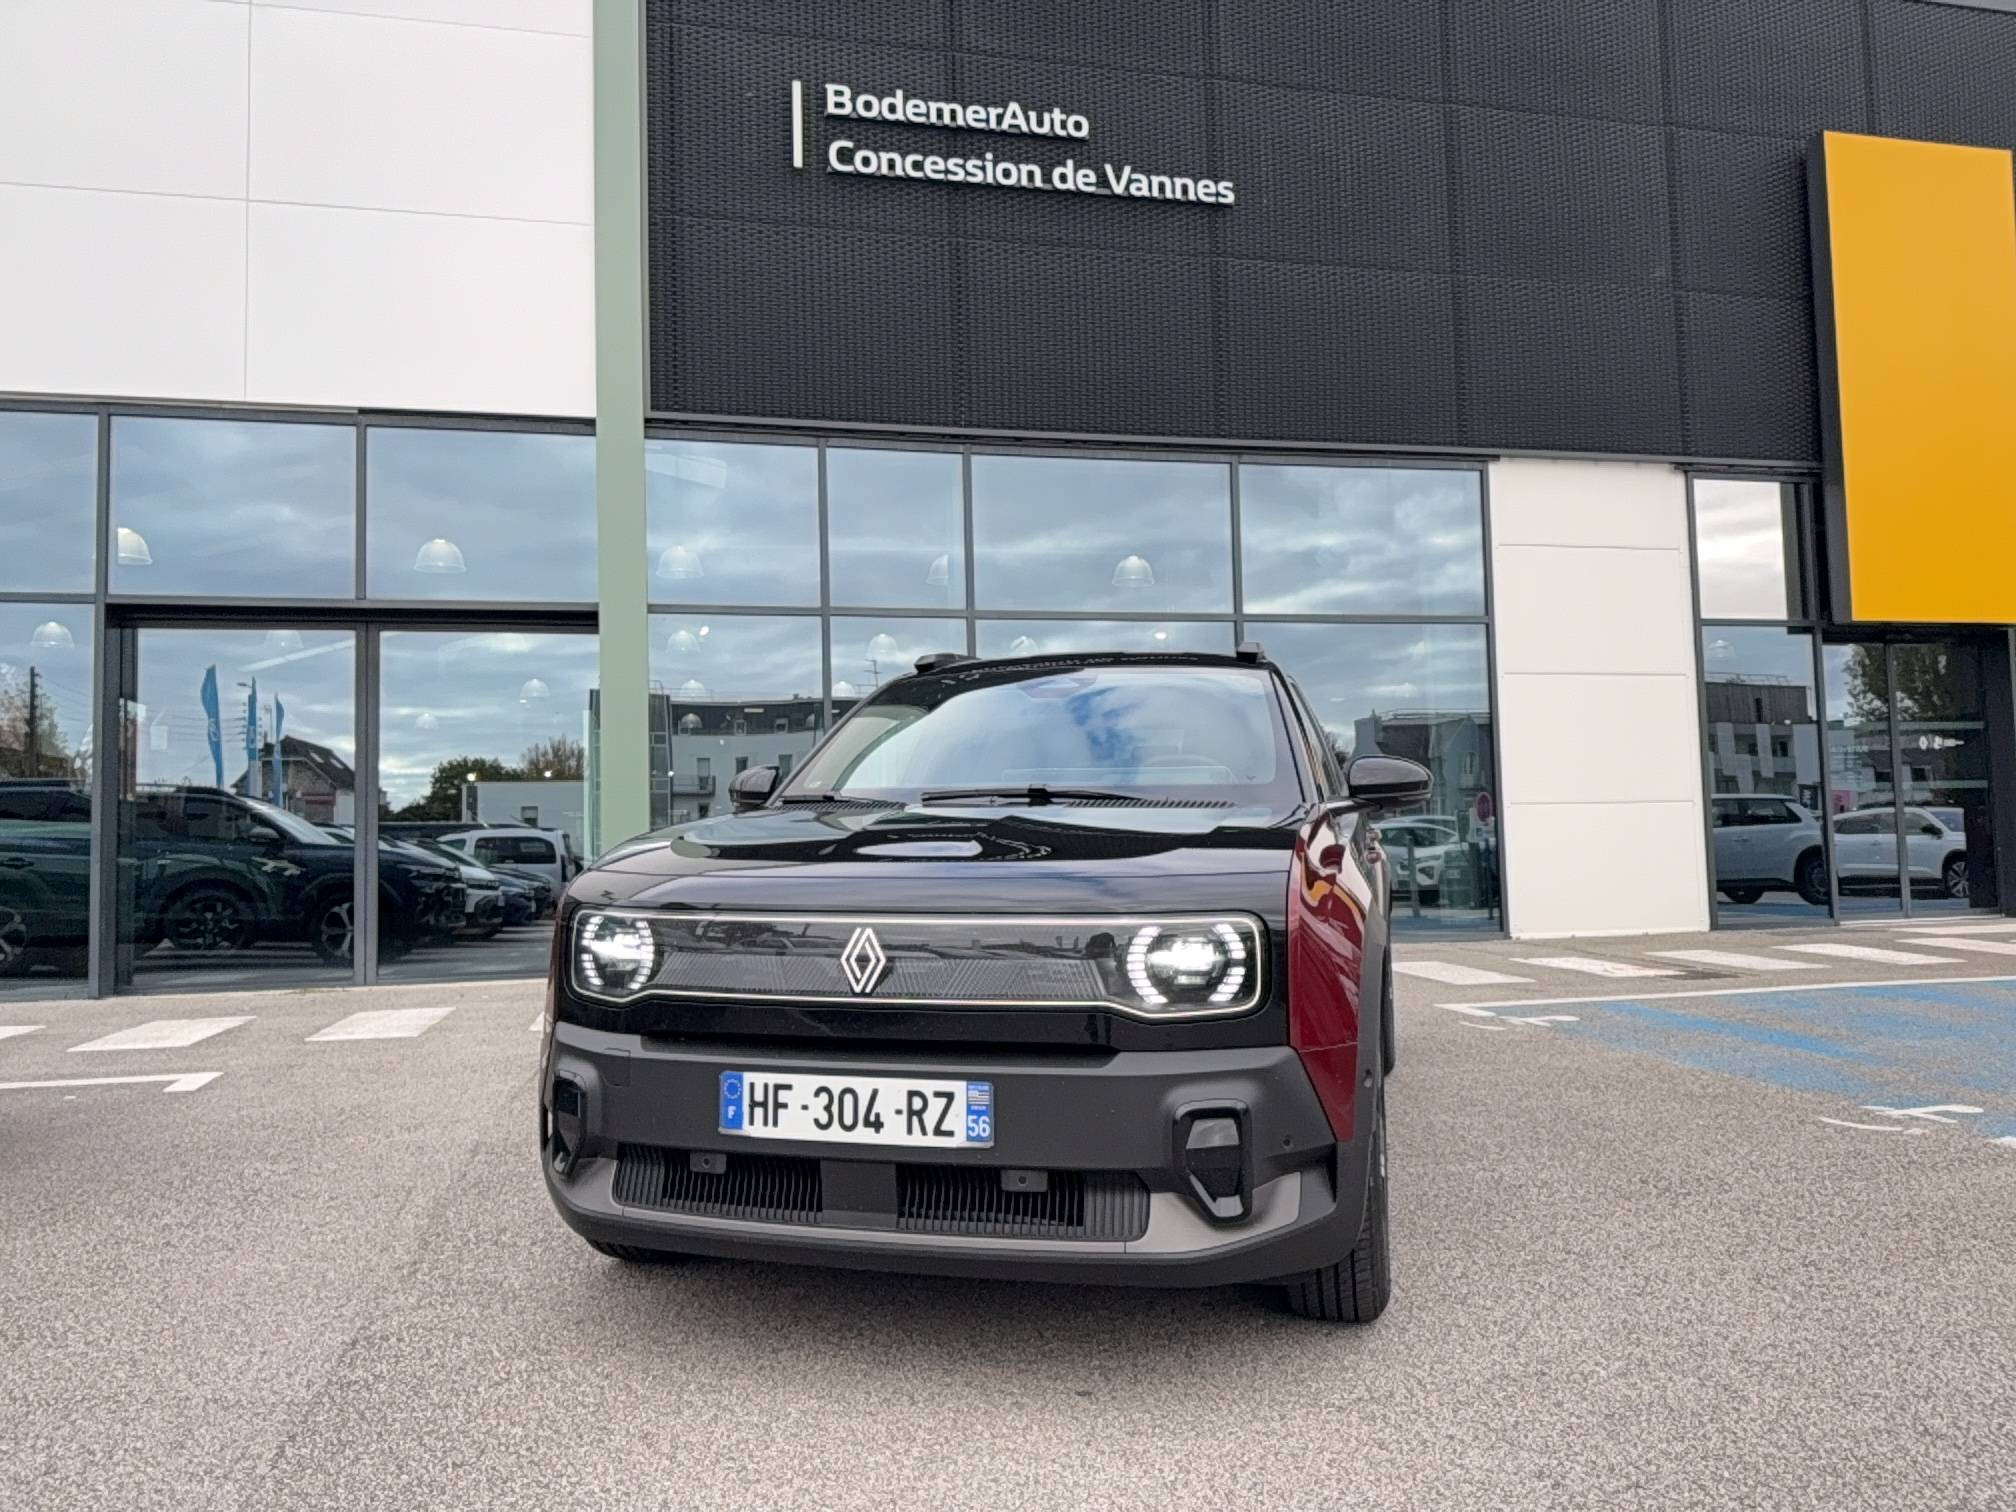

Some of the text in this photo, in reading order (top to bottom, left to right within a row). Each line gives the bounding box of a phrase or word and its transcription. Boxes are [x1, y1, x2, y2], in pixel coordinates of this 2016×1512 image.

[825, 83, 1090, 139] BodemerAuto
[827, 140, 1236, 204] Concession de Vannes
[727, 1105, 737, 1119] F
[749, 1081, 956, 1138] HF-304-RZ
[967, 1115, 991, 1137] 56
